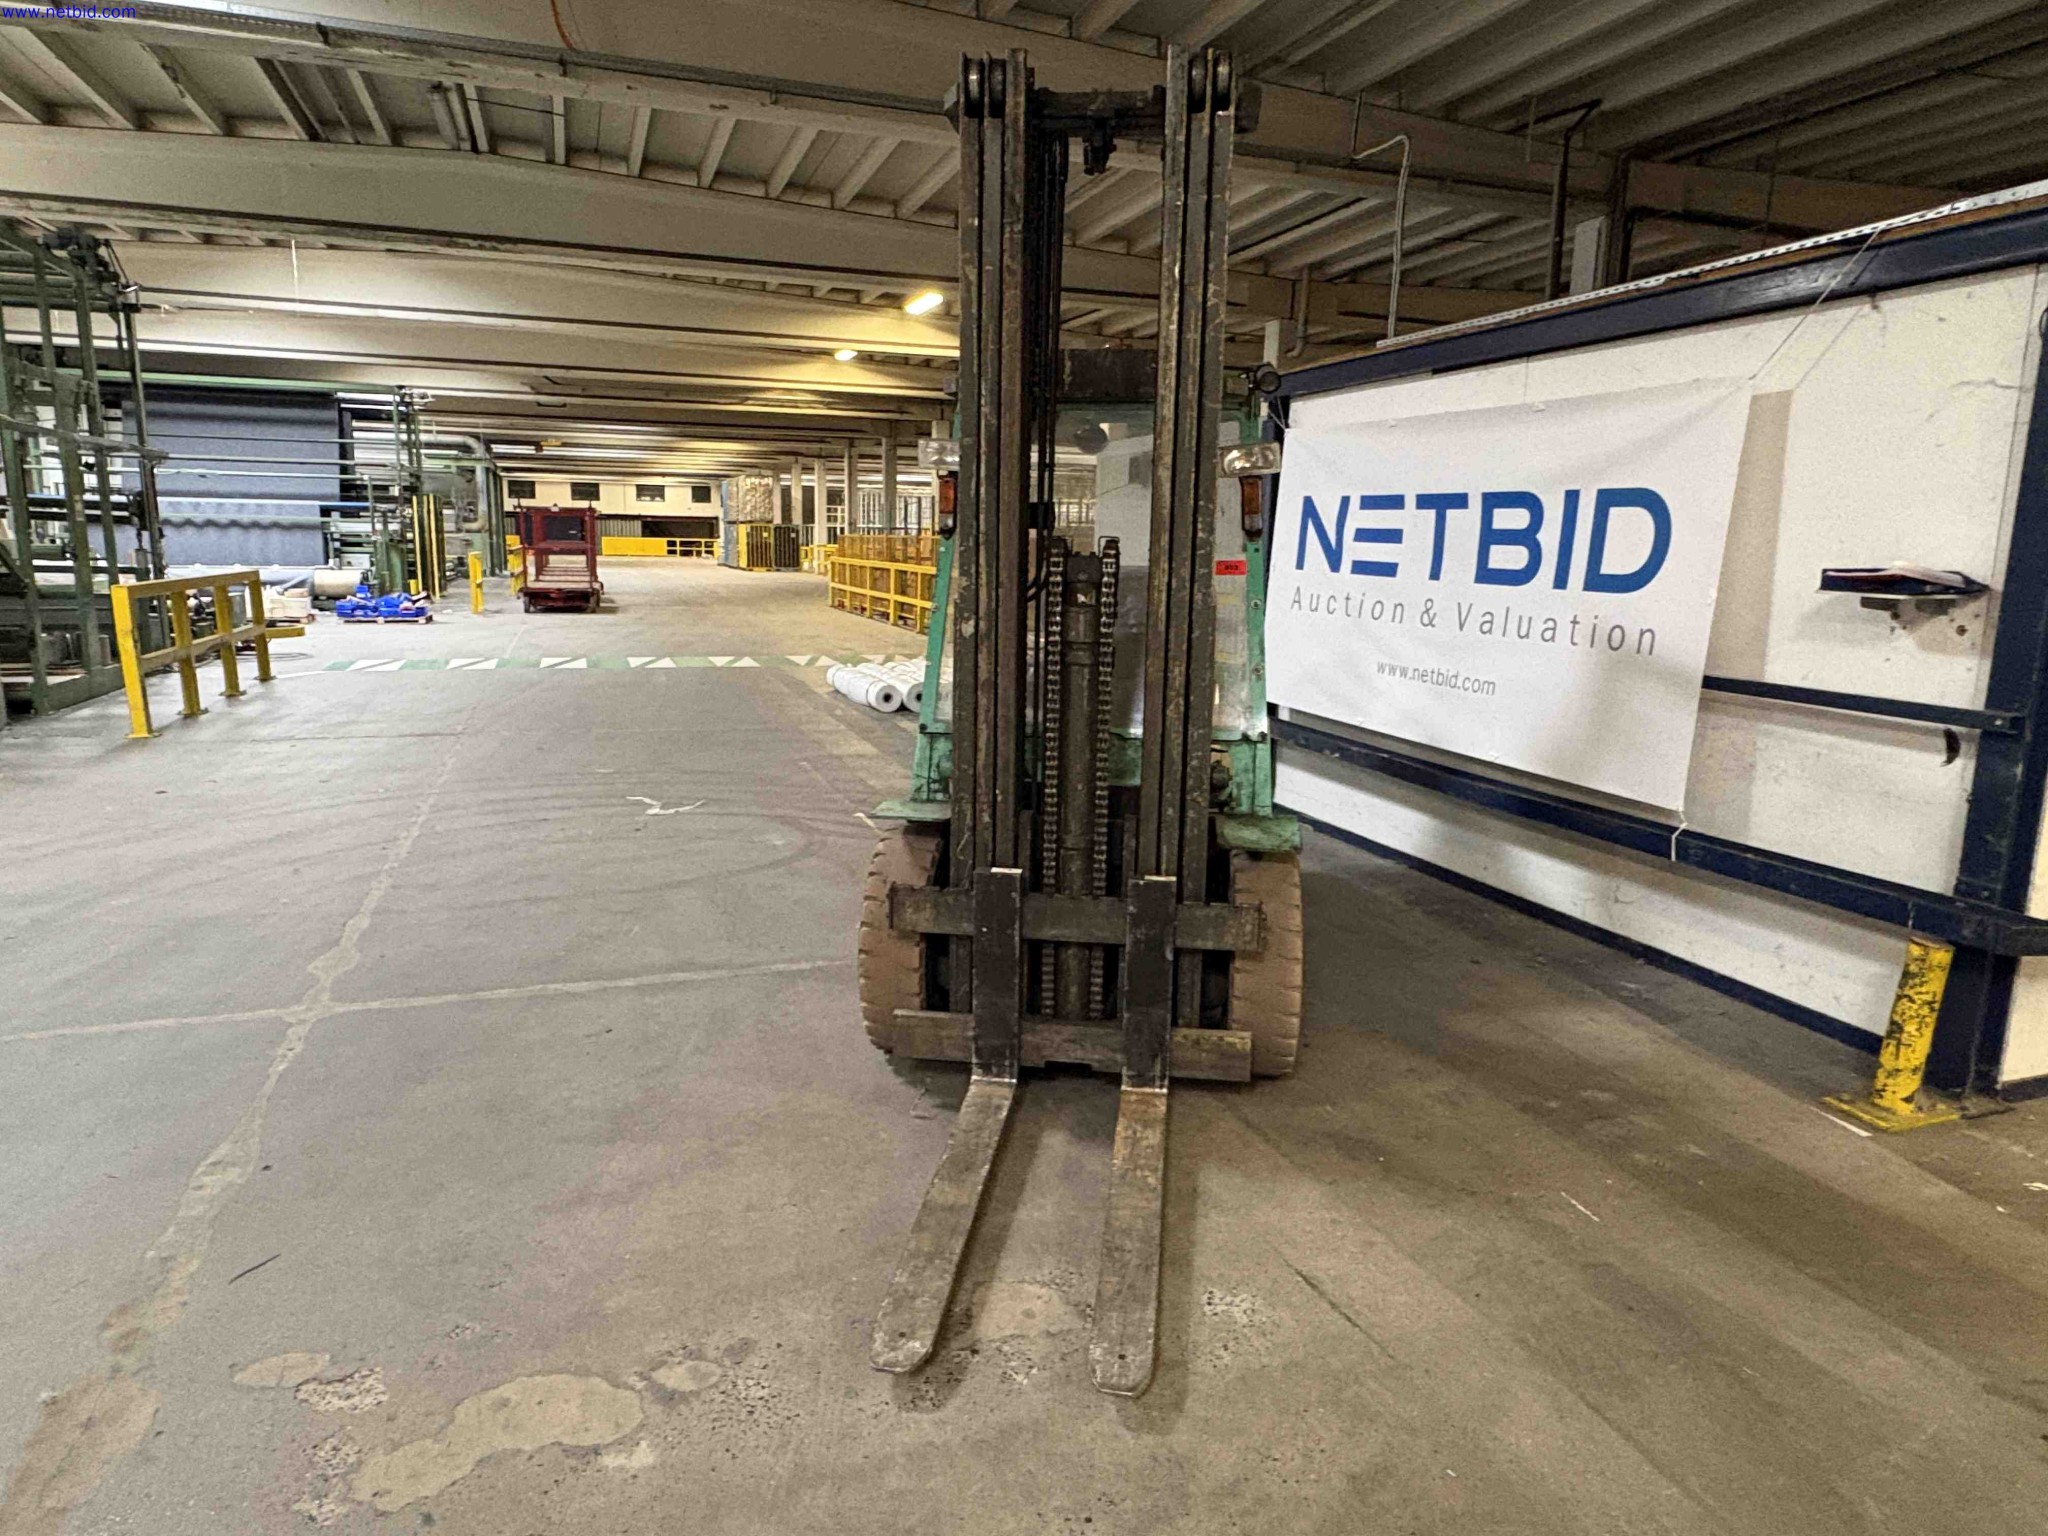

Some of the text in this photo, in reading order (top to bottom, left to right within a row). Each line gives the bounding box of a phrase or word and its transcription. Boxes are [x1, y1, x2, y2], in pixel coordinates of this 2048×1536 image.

[1295, 487, 1672, 594] NETBID
[1290, 586, 1657, 657] Auction & Valuation
[1376, 661, 1497, 696] www.netbid.com
